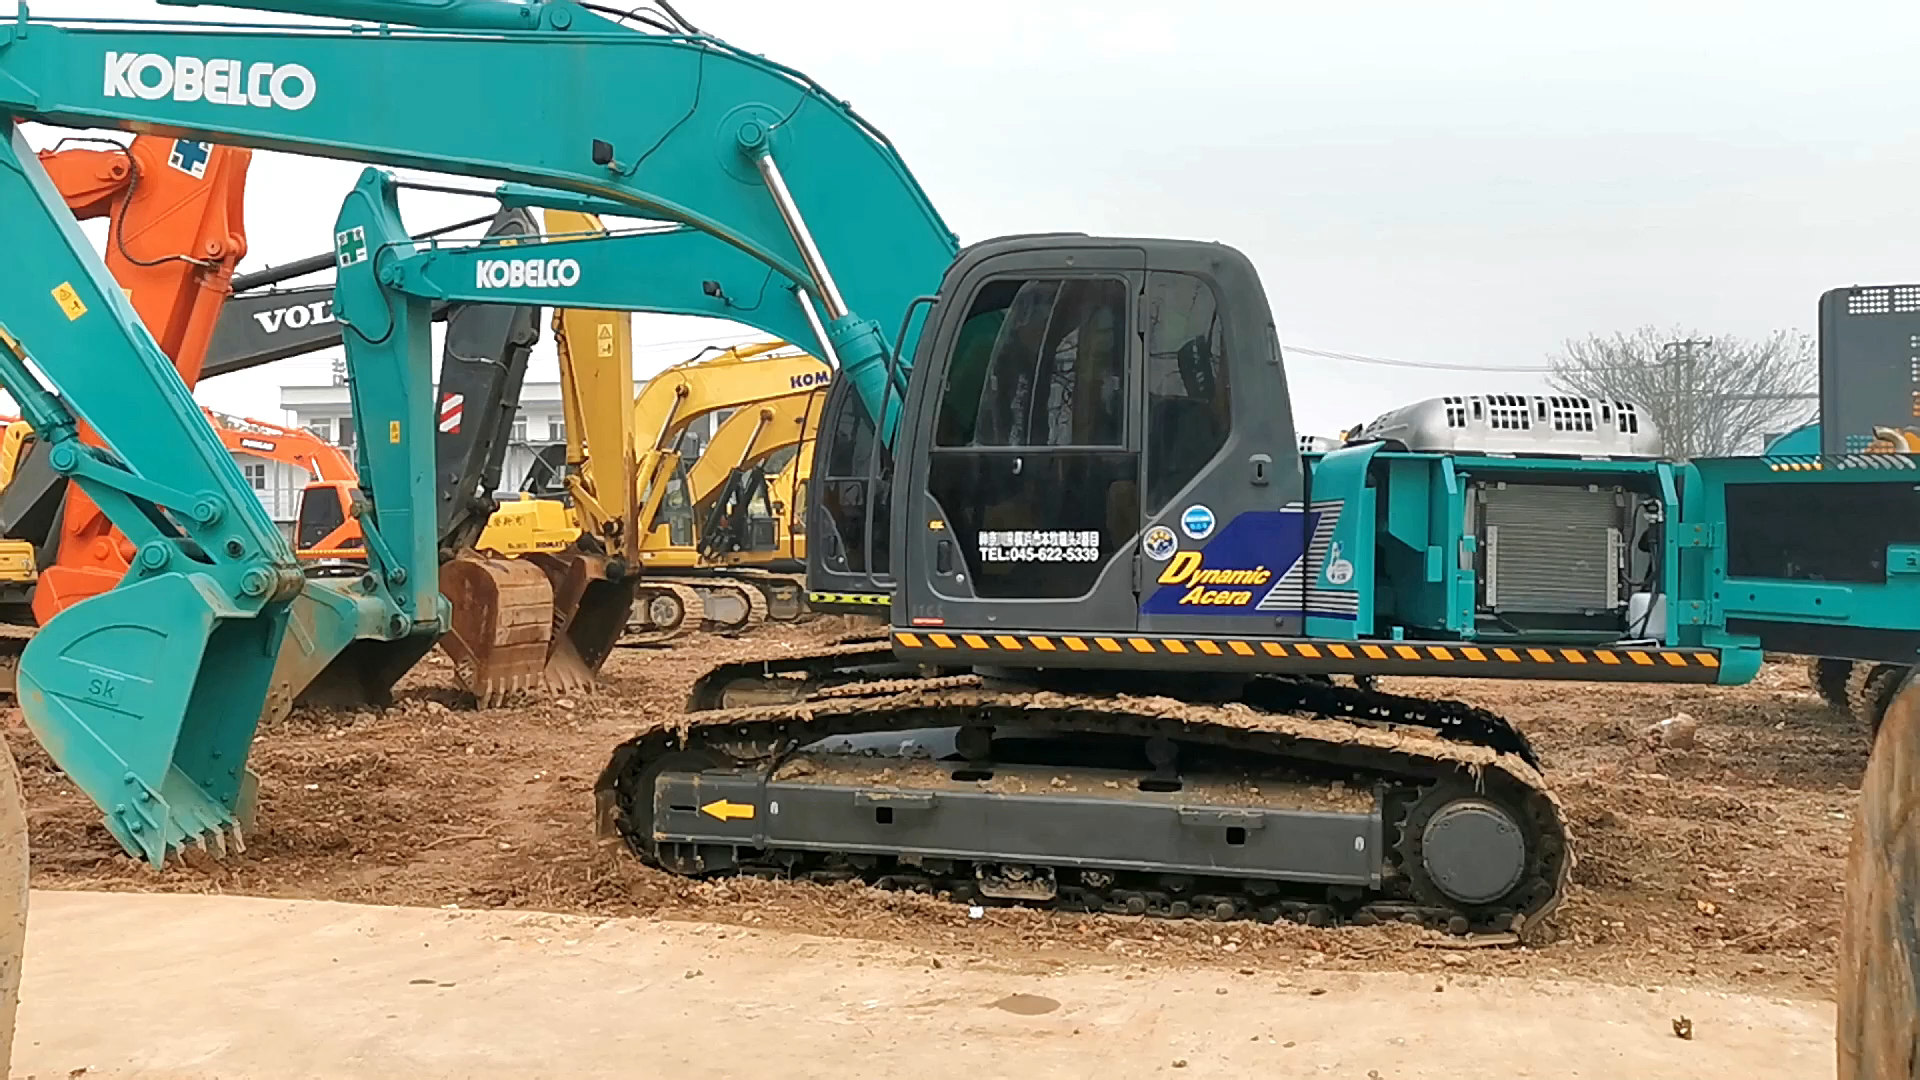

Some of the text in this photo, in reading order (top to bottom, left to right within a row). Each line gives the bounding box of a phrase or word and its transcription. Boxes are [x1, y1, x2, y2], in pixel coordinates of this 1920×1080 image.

[103, 51, 316, 111] KOBELCO
[476, 258, 581, 289] KOBELCO
[978, 547, 1100, 562] TEL:045-622-5339
[1157, 551, 1271, 588] Dynamic
[1178, 585, 1252, 605] Acera
